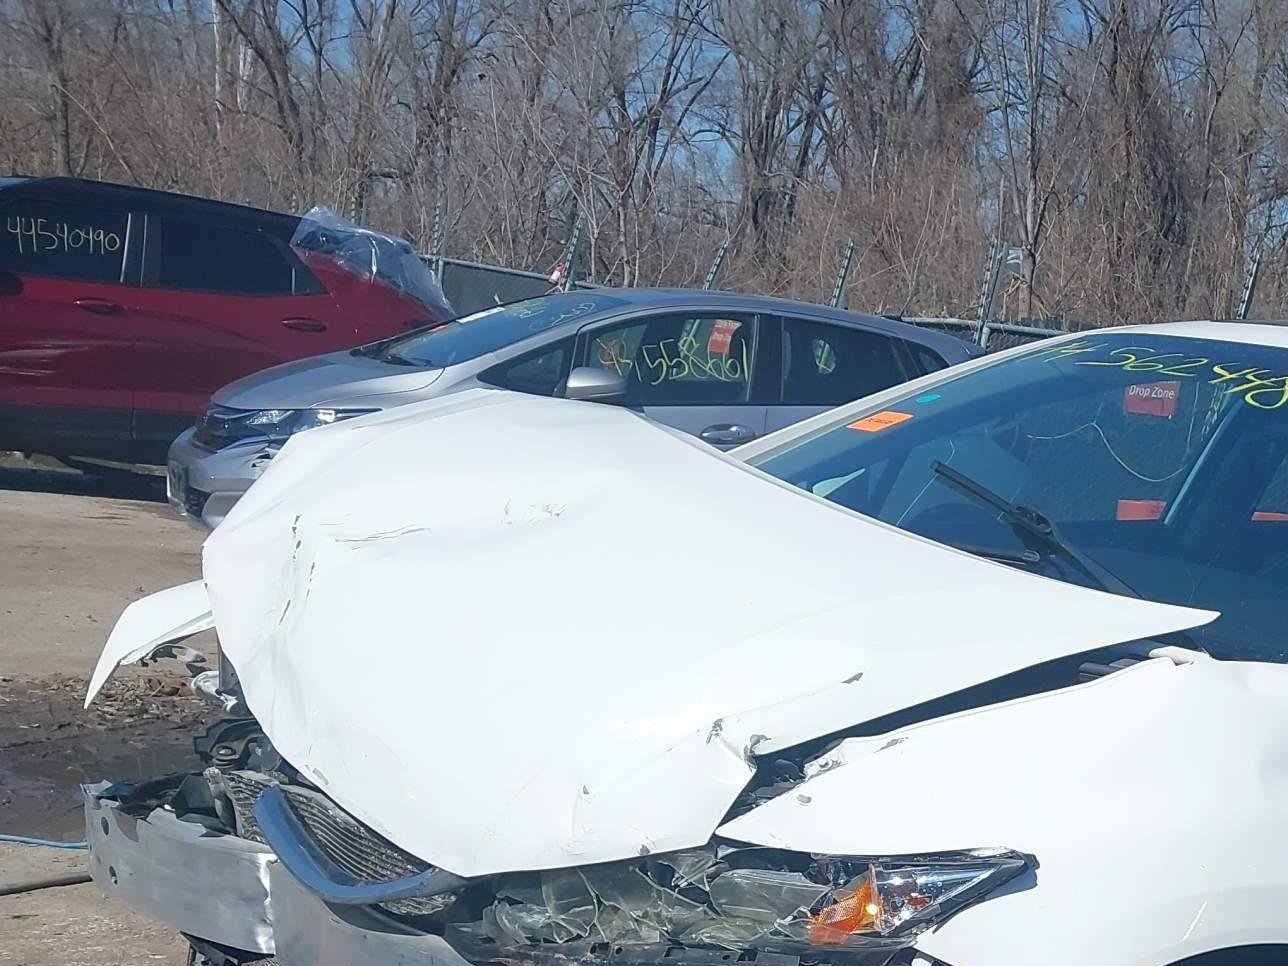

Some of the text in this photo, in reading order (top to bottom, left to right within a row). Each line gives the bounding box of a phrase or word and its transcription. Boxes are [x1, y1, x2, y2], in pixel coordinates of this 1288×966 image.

[7, 215, 120, 255] 44540490
[1128, 384, 1176, 400] Drop Zone
